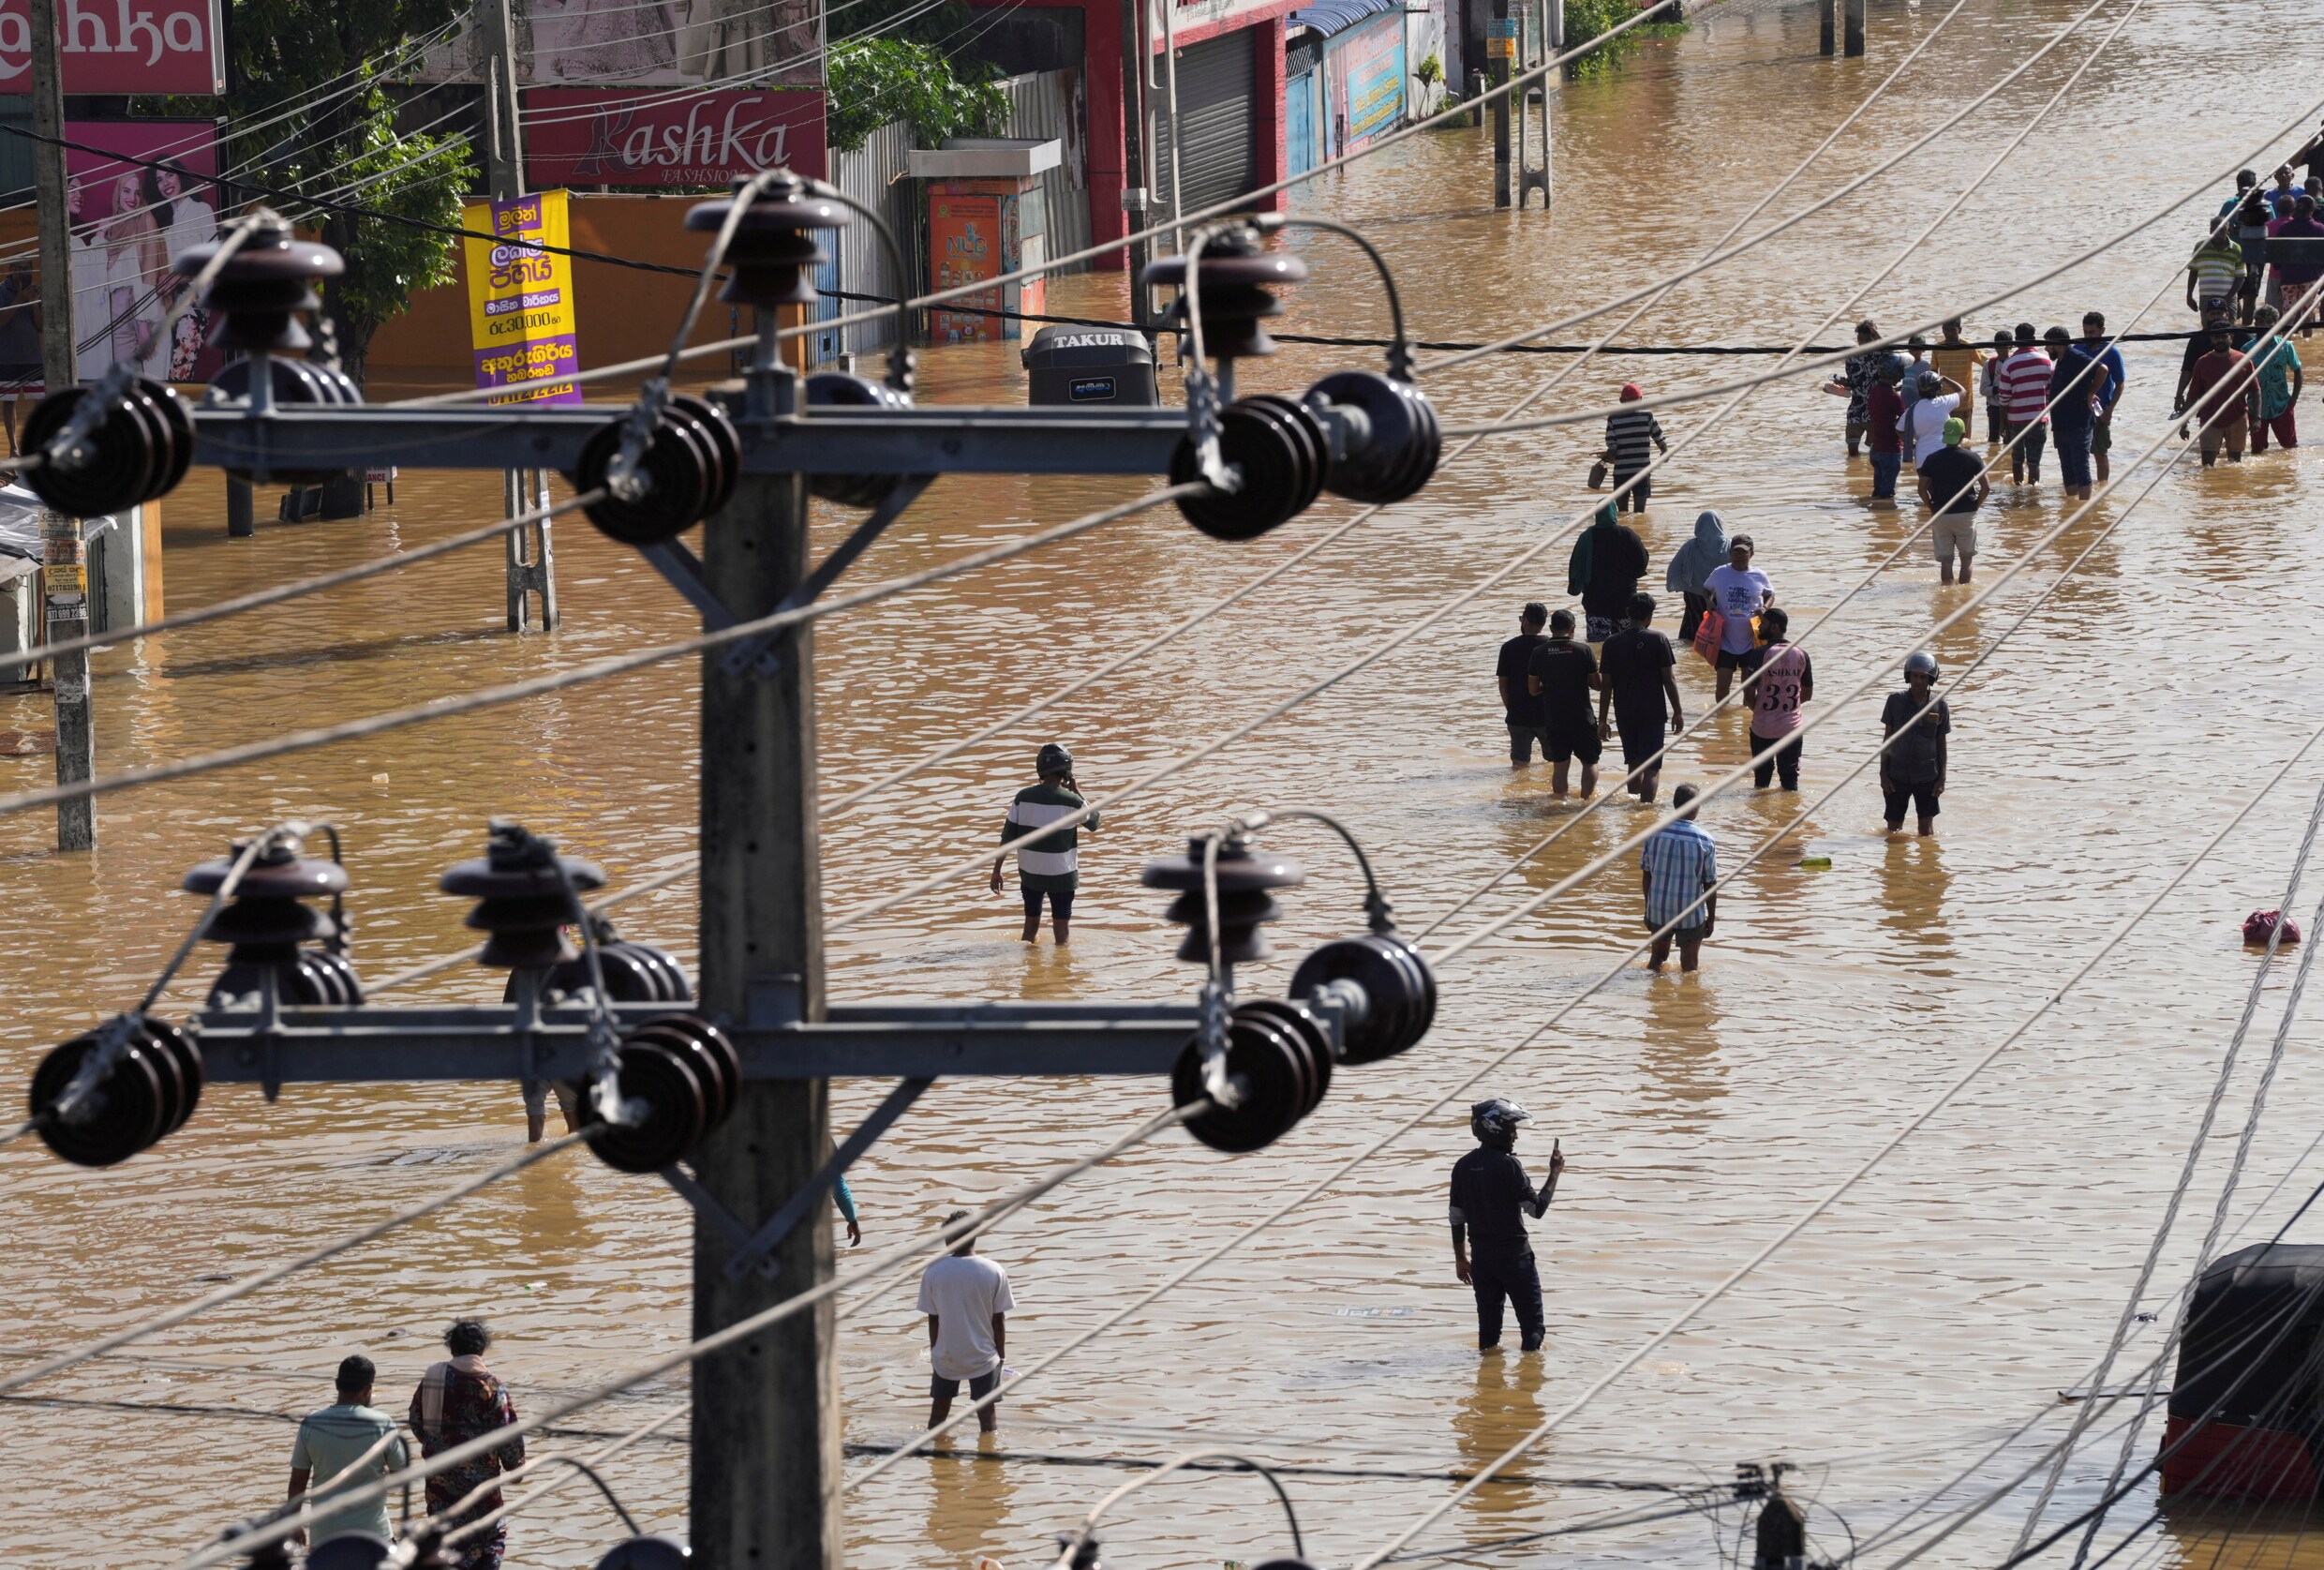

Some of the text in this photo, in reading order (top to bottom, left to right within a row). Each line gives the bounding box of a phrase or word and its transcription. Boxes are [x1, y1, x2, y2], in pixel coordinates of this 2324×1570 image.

[1054, 334, 1125, 348] TAKUR
[47, 607, 87, 620] 077 699 2396
[1763, 683, 1798, 712] 33
